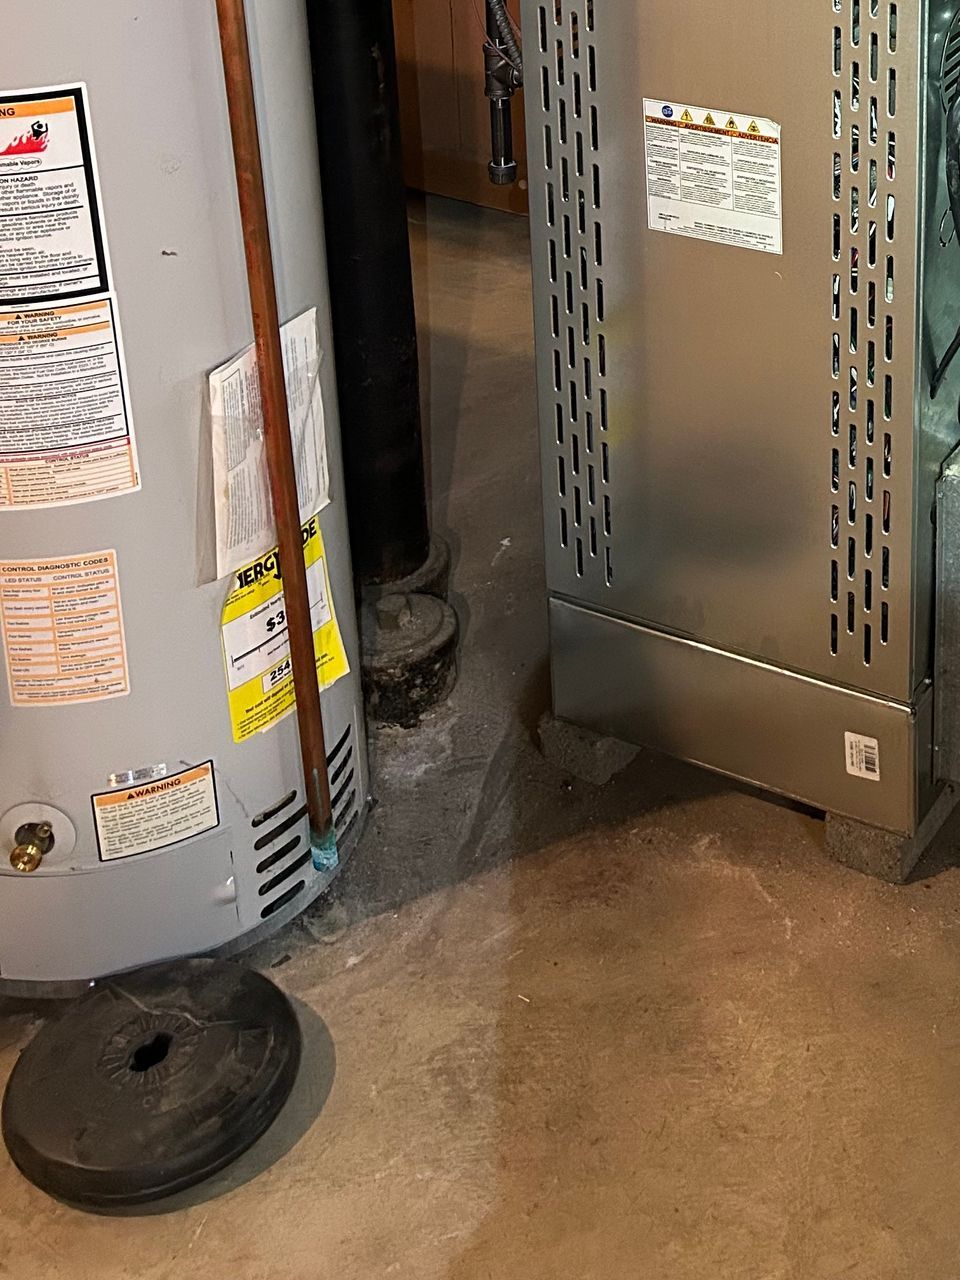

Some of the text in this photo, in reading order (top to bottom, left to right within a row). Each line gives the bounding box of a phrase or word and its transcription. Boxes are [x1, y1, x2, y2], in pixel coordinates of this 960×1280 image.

[24, 311, 55, 319] WARNING
[27, 332, 58, 341] WARNING
[38, 562, 81, 571] DIAGNOSTIC
[83, 558, 108, 568] CODES
[135, 778, 182, 798] WARNING
